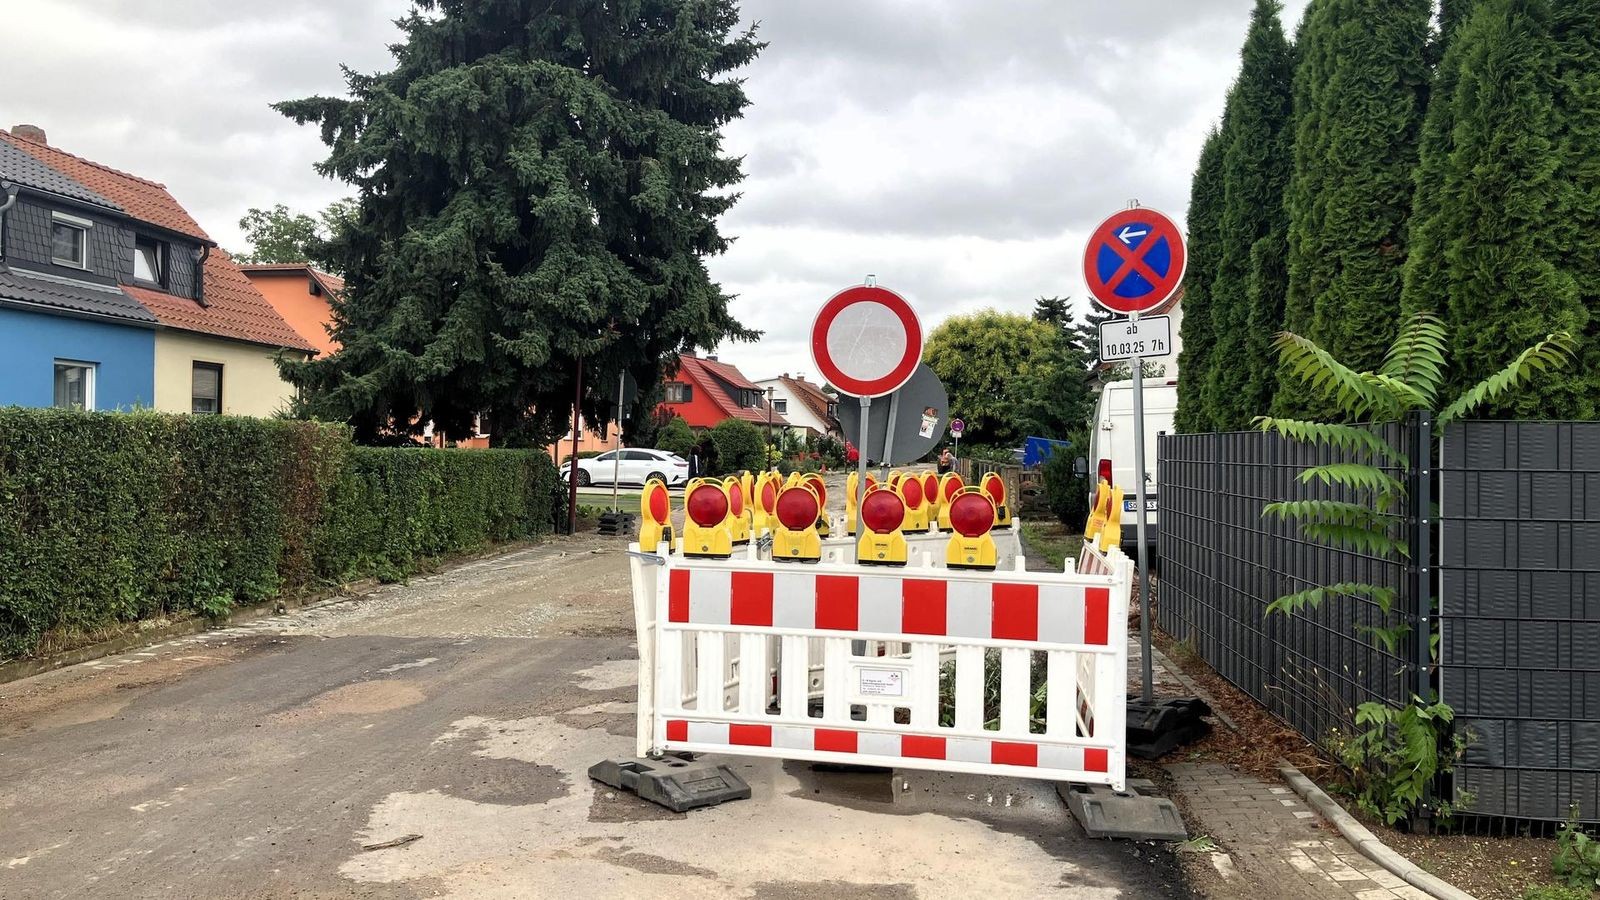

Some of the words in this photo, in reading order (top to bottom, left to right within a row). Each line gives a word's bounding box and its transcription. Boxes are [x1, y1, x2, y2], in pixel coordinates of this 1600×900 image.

[1126, 323, 1138, 335] ab
[1106, 341, 1145, 356] 10.03.25
[1151, 339, 1164, 351] 7h
